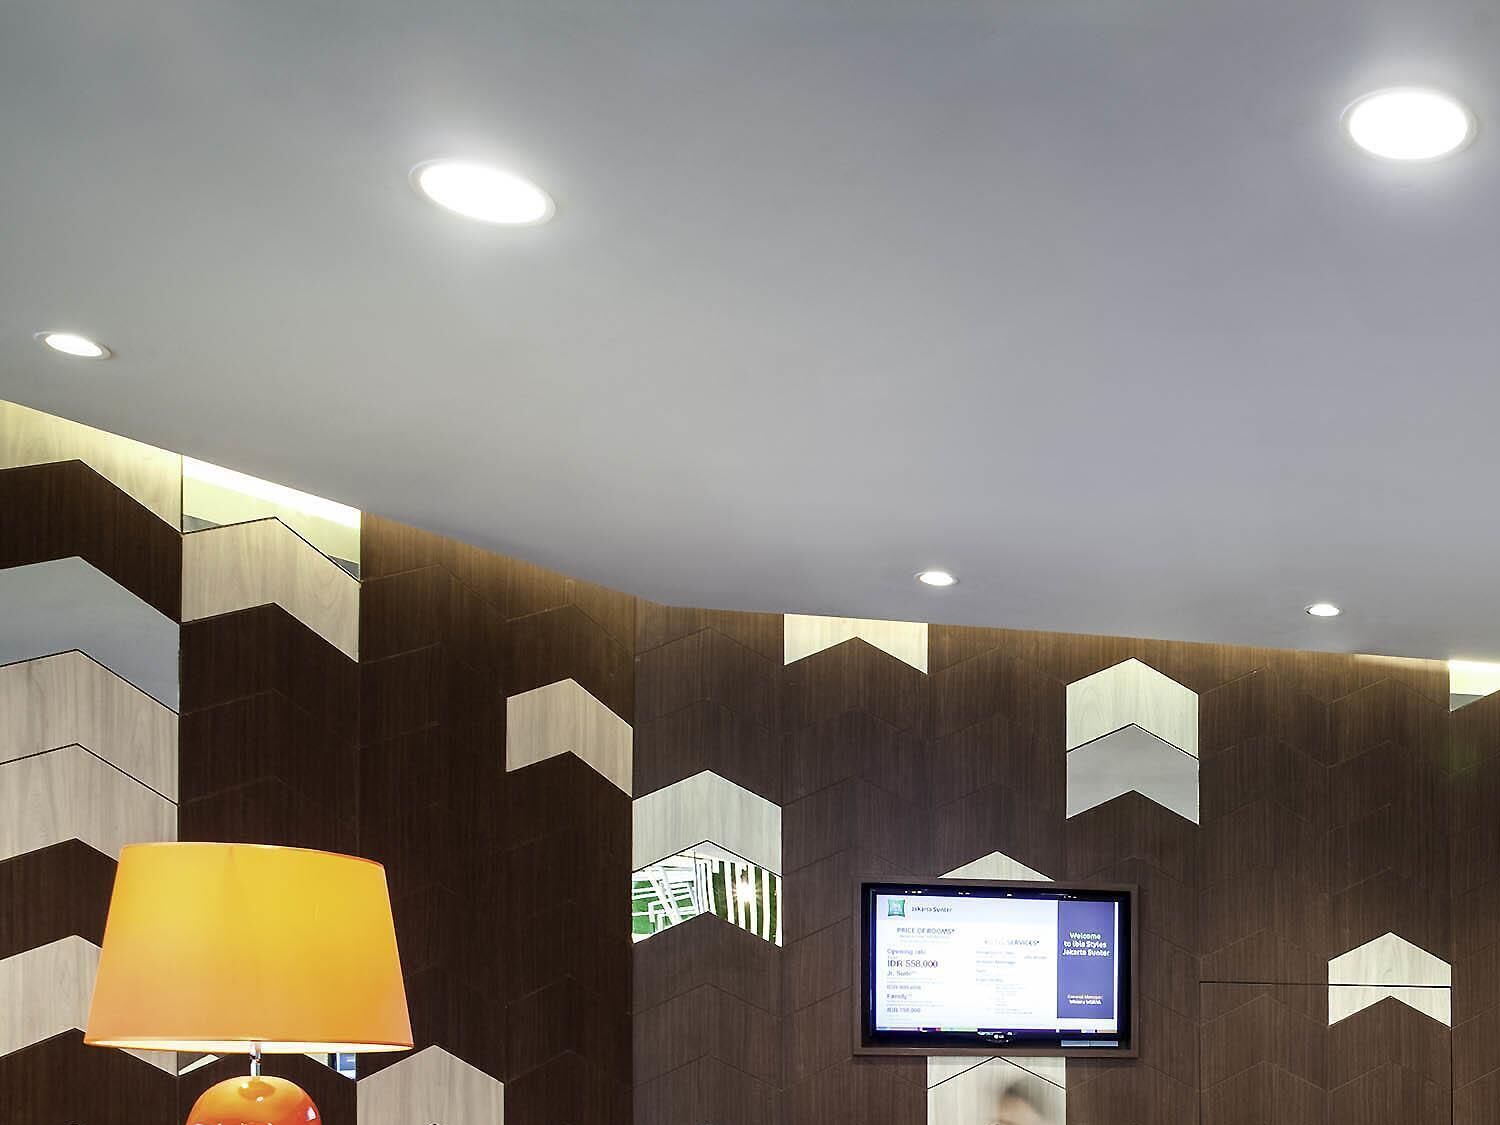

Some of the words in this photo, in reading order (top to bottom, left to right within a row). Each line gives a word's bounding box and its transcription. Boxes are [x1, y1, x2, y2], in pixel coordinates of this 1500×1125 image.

[1069, 932, 1101, 940] Welcome
[1063, 940, 1072, 948] to
[1086, 940, 1107, 949] Styles
[1087, 949, 1111, 957] Sunter
[887, 959, 903, 968] IDR
